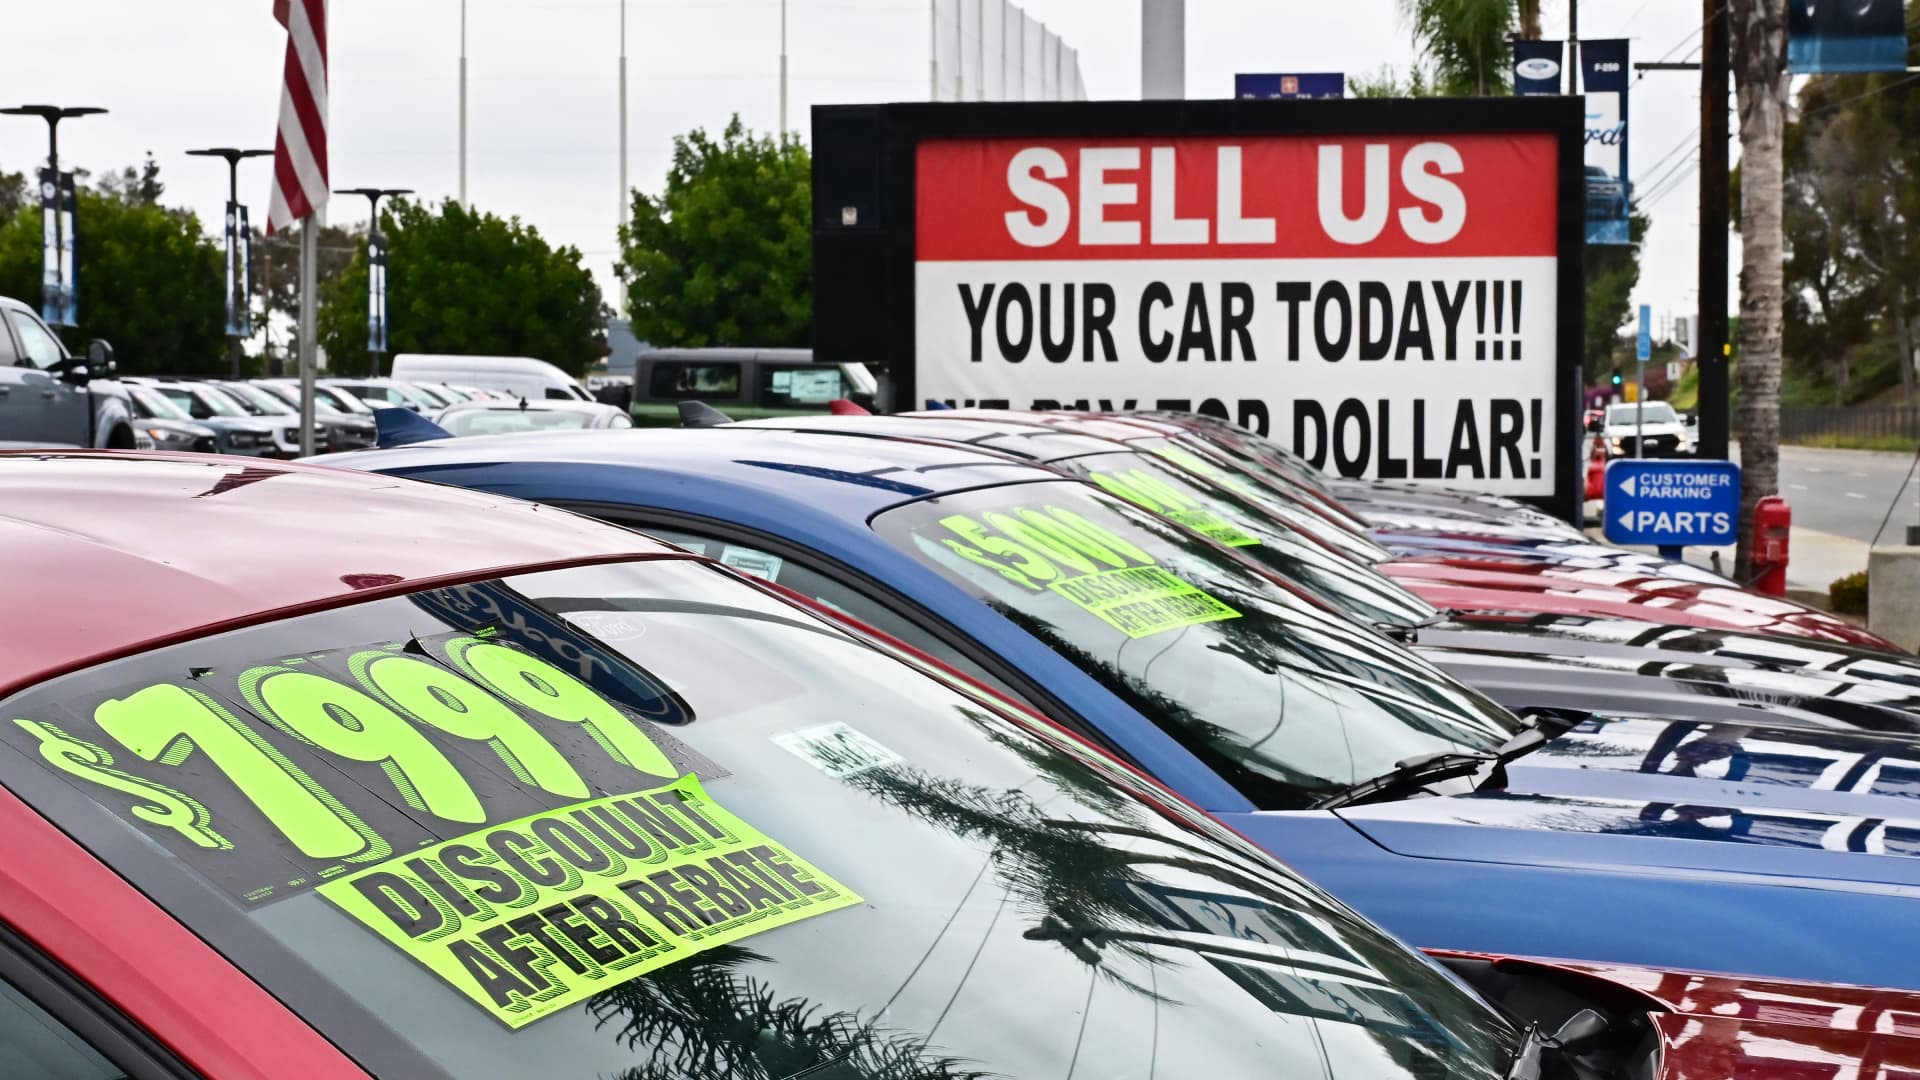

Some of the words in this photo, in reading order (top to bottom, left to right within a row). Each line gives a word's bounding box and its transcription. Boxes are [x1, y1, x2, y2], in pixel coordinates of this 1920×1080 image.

[1004, 146, 1276, 248] SELL
[1317, 141, 1467, 245] US
[957, 281, 1119, 363] YOUR
[1138, 281, 1257, 363] CAR
[1276, 280, 1523, 363] TODAY!!!
[1293, 398, 1543, 480] DOLLAR!
[1640, 473, 1731, 486] CUSTOMER
[1637, 511, 1731, 534] PARTS
[1640, 486, 1712, 499] PARKING
[350, 789, 736, 940] DISCOUNT
[447, 895, 666, 1010] AFTER
[616, 845, 834, 938] REBATE
